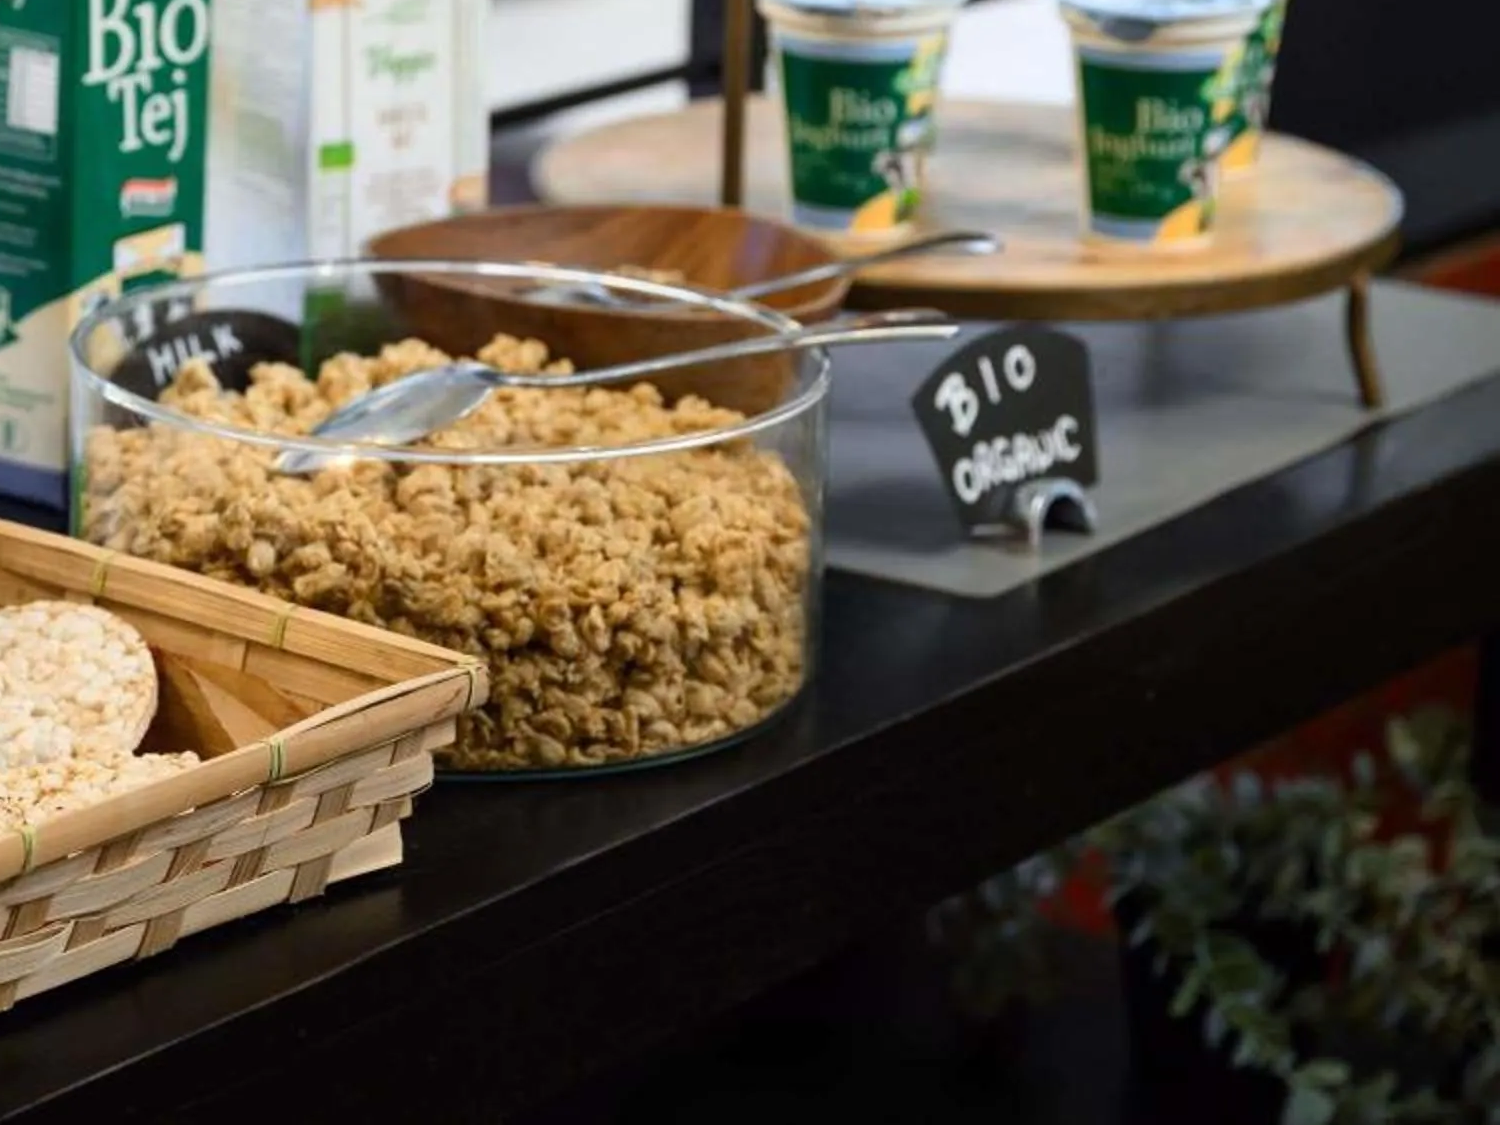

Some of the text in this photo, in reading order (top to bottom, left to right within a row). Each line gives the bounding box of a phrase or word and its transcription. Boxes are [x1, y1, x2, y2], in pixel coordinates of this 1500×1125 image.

[107, 71, 190, 162] Tej
[147, 324, 244, 386] MILK
[934, 343, 1037, 438] BIO
